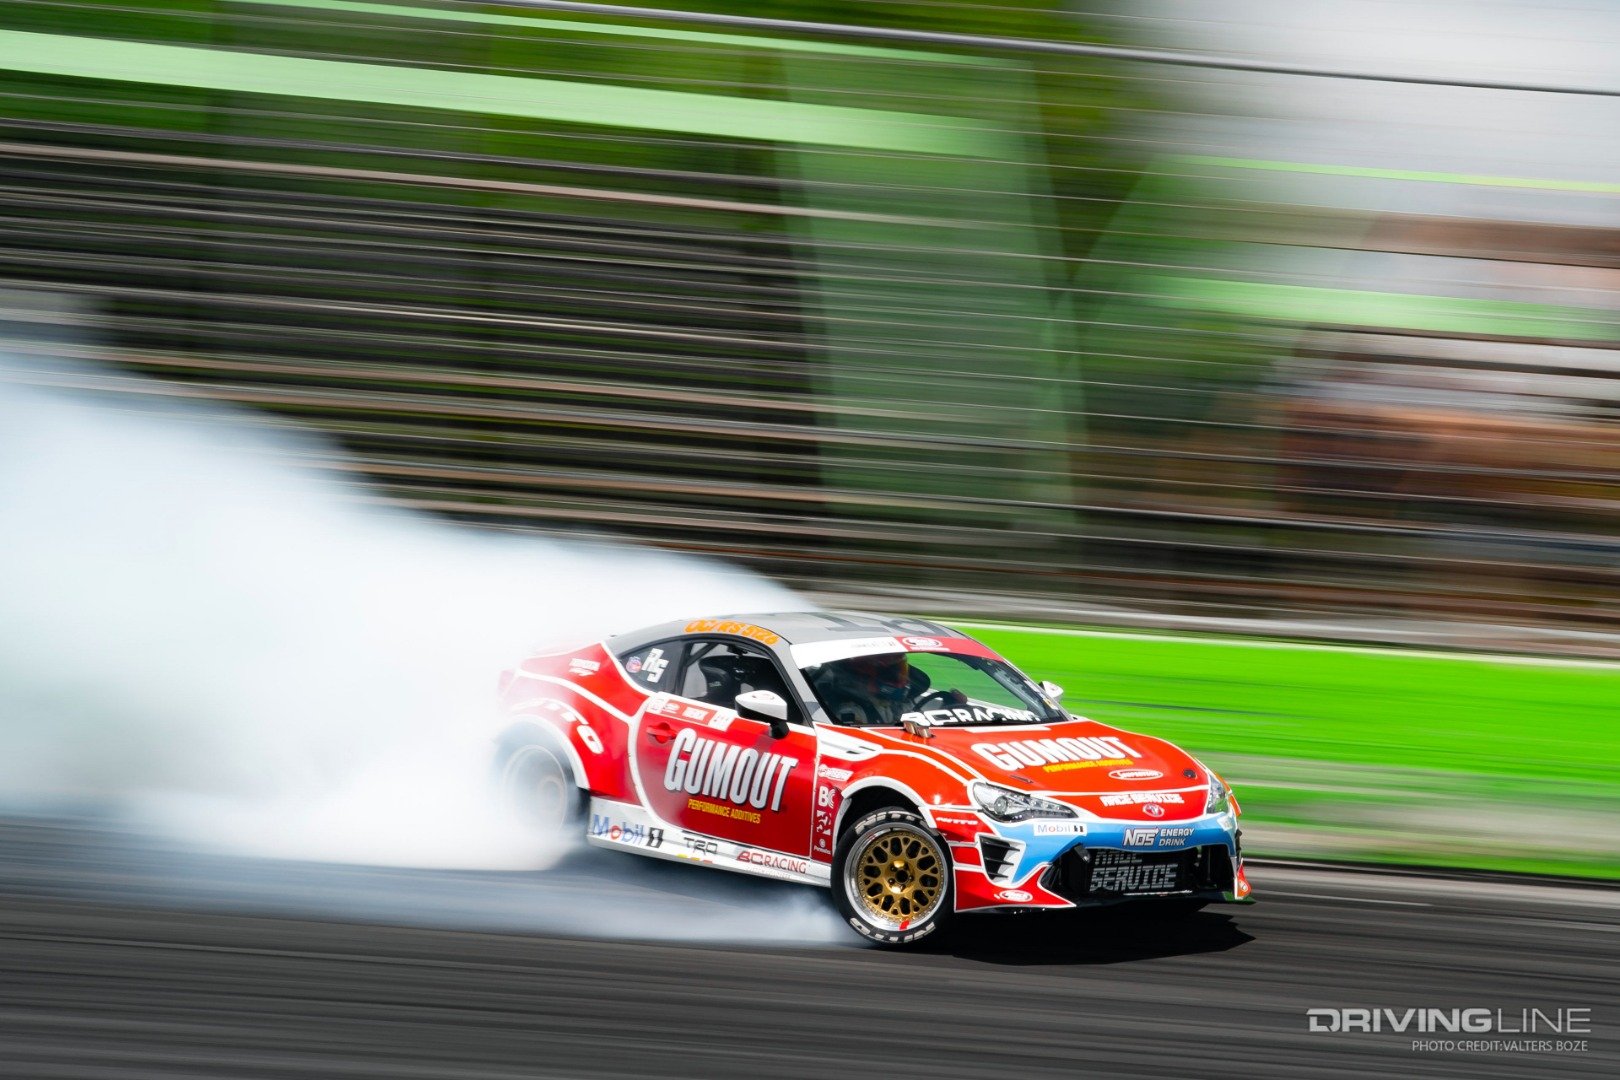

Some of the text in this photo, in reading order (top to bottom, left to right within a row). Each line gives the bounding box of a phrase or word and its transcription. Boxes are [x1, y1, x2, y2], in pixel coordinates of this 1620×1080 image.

[971, 736, 1143, 772] GUMOUT
[664, 727, 799, 812] GUMOUT
[1043, 761, 1097, 773] PERFORMANCE
[1099, 794, 1134, 807] RACE
[688, 798, 761, 825] PERFORMANCE ADDITIVES
[592, 814, 645, 846] Mobil
[1037, 824, 1072, 834] Mobil
[1122, 826, 1195, 847] NOS ENERGY
[683, 837, 718, 856] TRD
[1158, 838, 1186, 847] DRINK
[1089, 863, 1178, 891] SERVICE
